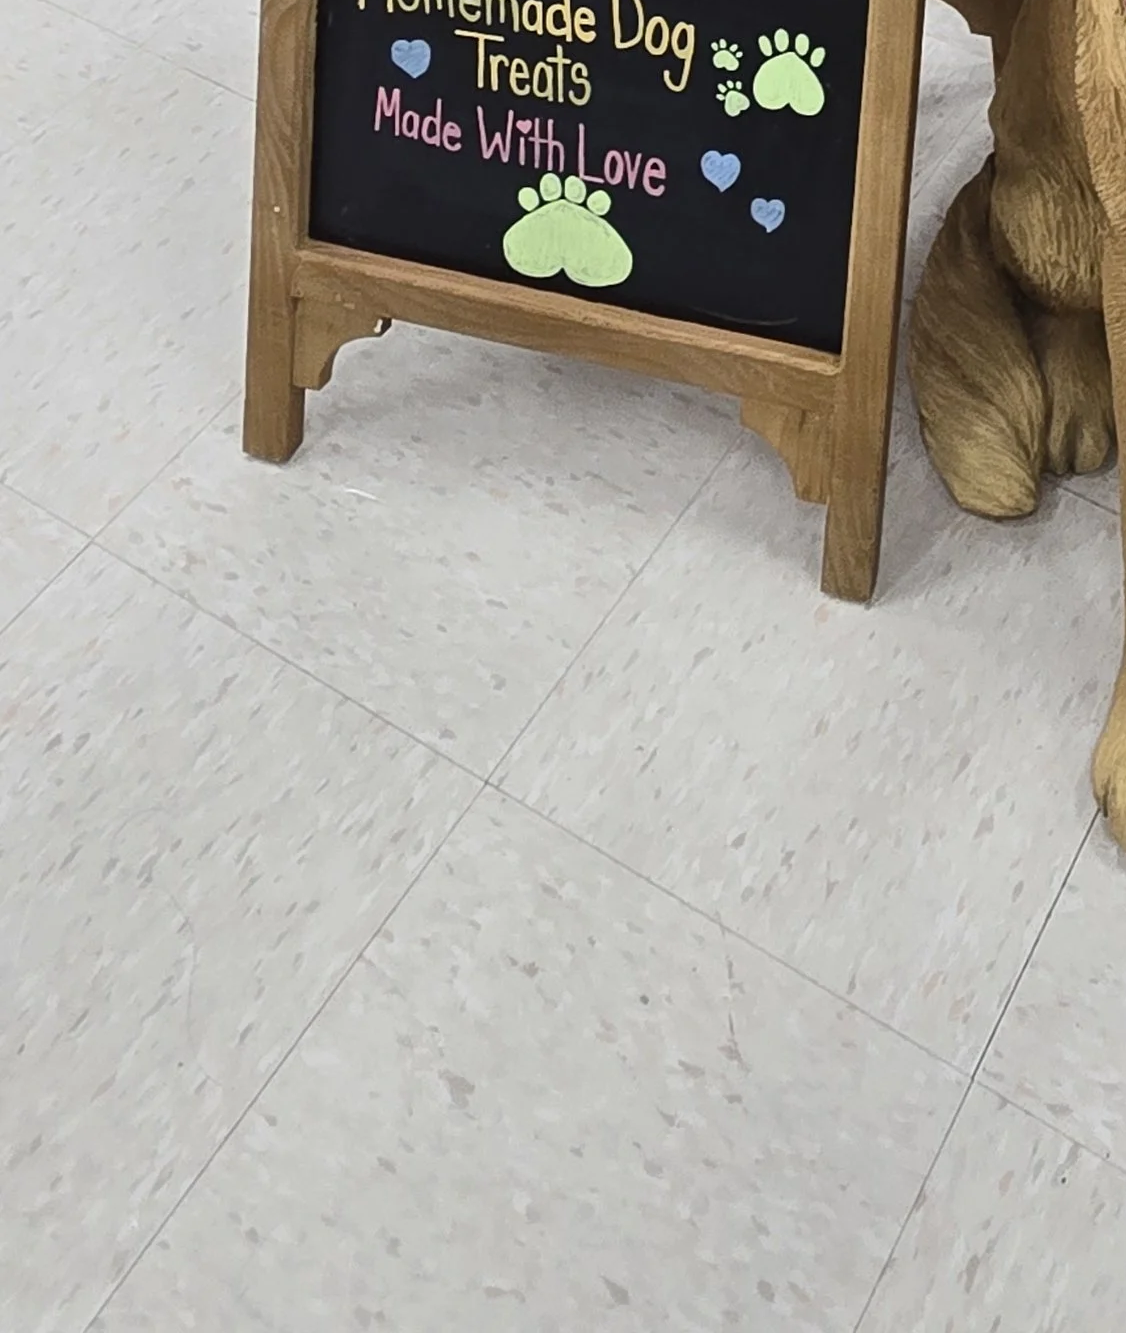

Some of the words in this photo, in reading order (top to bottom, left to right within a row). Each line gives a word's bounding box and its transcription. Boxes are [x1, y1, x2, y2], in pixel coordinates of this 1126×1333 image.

[454, 28, 593, 107] Treats
[374, 85, 463, 152] Made
[476, 104, 566, 173] With
[578, 122, 668, 197] Love
